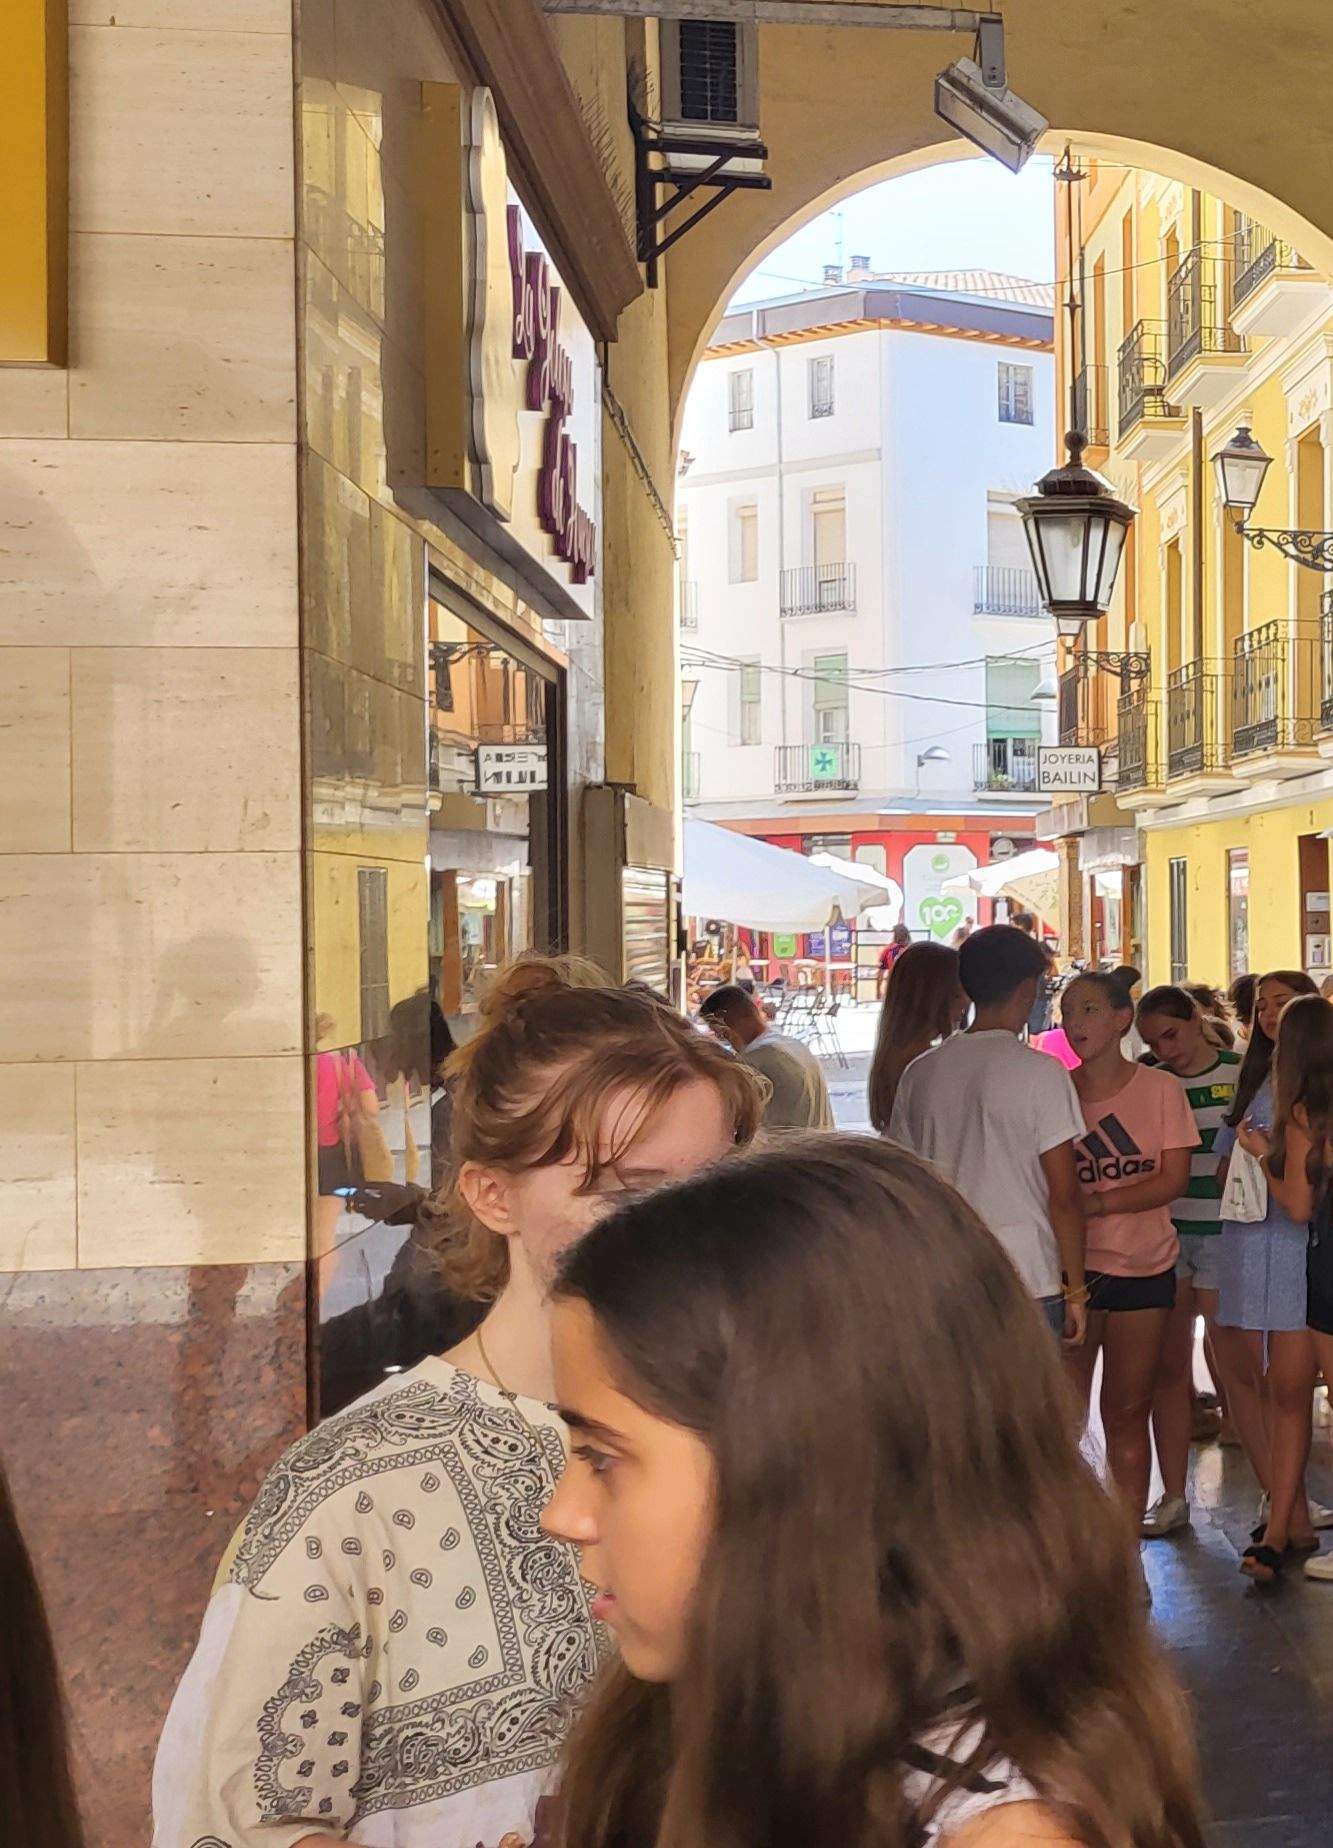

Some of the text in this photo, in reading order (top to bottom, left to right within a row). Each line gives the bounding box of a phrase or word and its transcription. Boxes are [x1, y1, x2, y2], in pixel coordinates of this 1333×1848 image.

[1042, 753, 1095, 765] JOYERIA
[1042, 771, 1096, 785] BAILIN
[1078, 1156, 1155, 1183] didas
